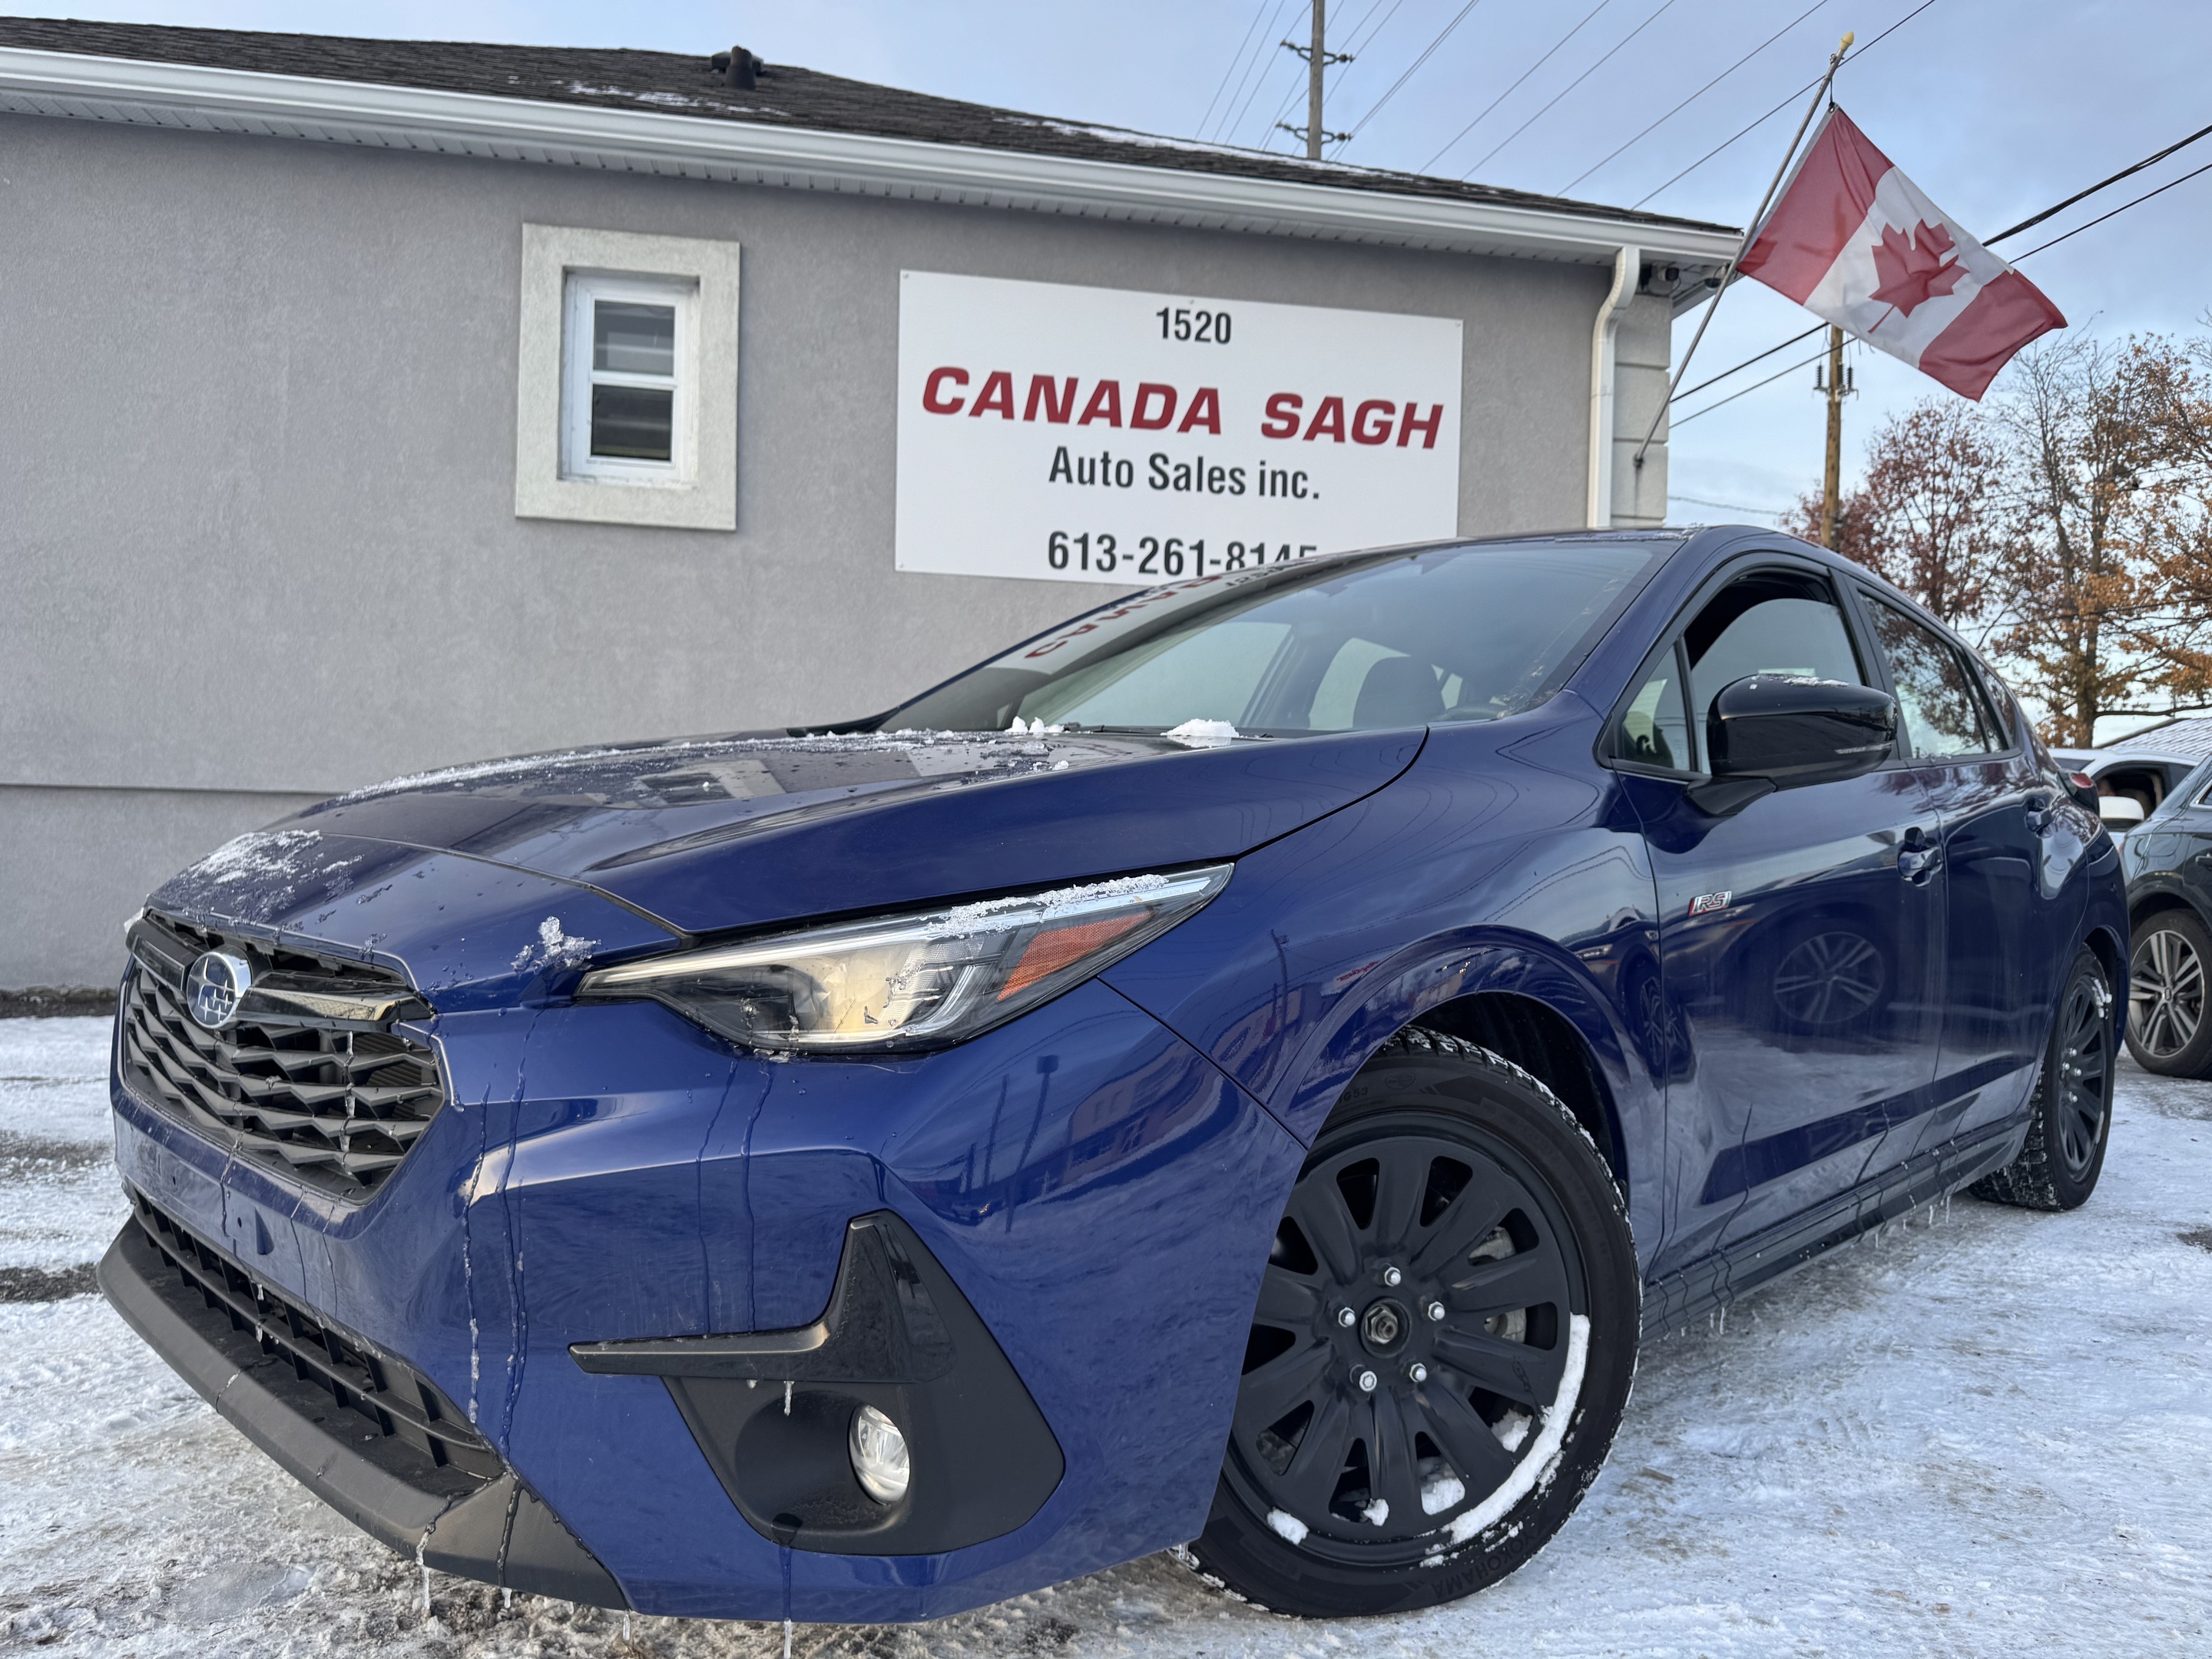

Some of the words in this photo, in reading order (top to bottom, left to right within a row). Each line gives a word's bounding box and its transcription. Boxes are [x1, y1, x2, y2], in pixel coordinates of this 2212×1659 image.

[1155, 307, 1232, 345] 1520
[922, 366, 1221, 435] CANADA
[1261, 392, 1443, 449] SAGH
[1048, 445, 1134, 488] Auto
[1147, 452, 1247, 495] Sales
[1258, 460, 1320, 499] inc.
[1153, 889, 1185, 898] SUBARU
[1694, 892, 1729, 913] RS
[1431, 1532, 1535, 1598] YOKOHAMA
